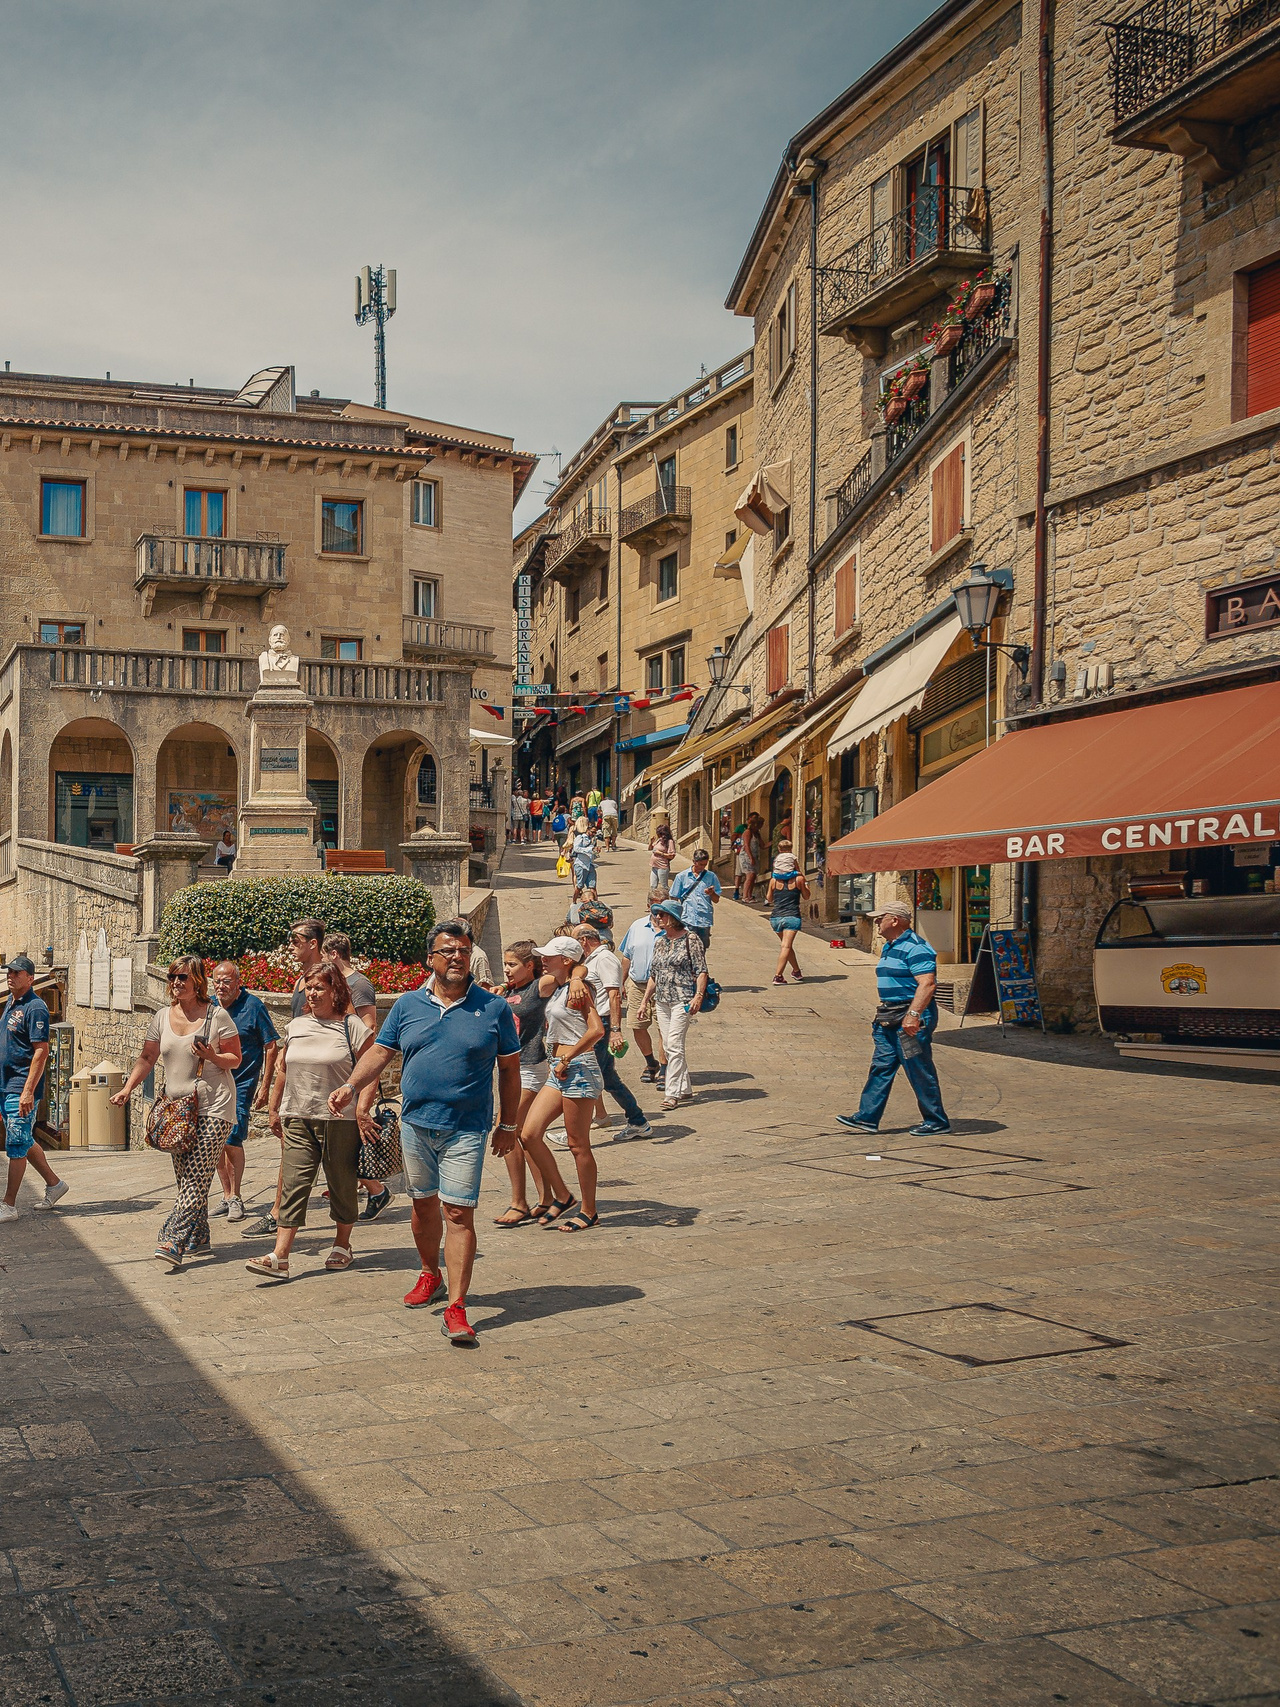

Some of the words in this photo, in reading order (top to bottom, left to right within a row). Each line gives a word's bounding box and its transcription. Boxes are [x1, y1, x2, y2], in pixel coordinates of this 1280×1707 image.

[520, 576, 530, 684] RISTORANTE
[1006, 833, 1065, 859] BAR
[1101, 812, 1280, 850] CENTRAL
